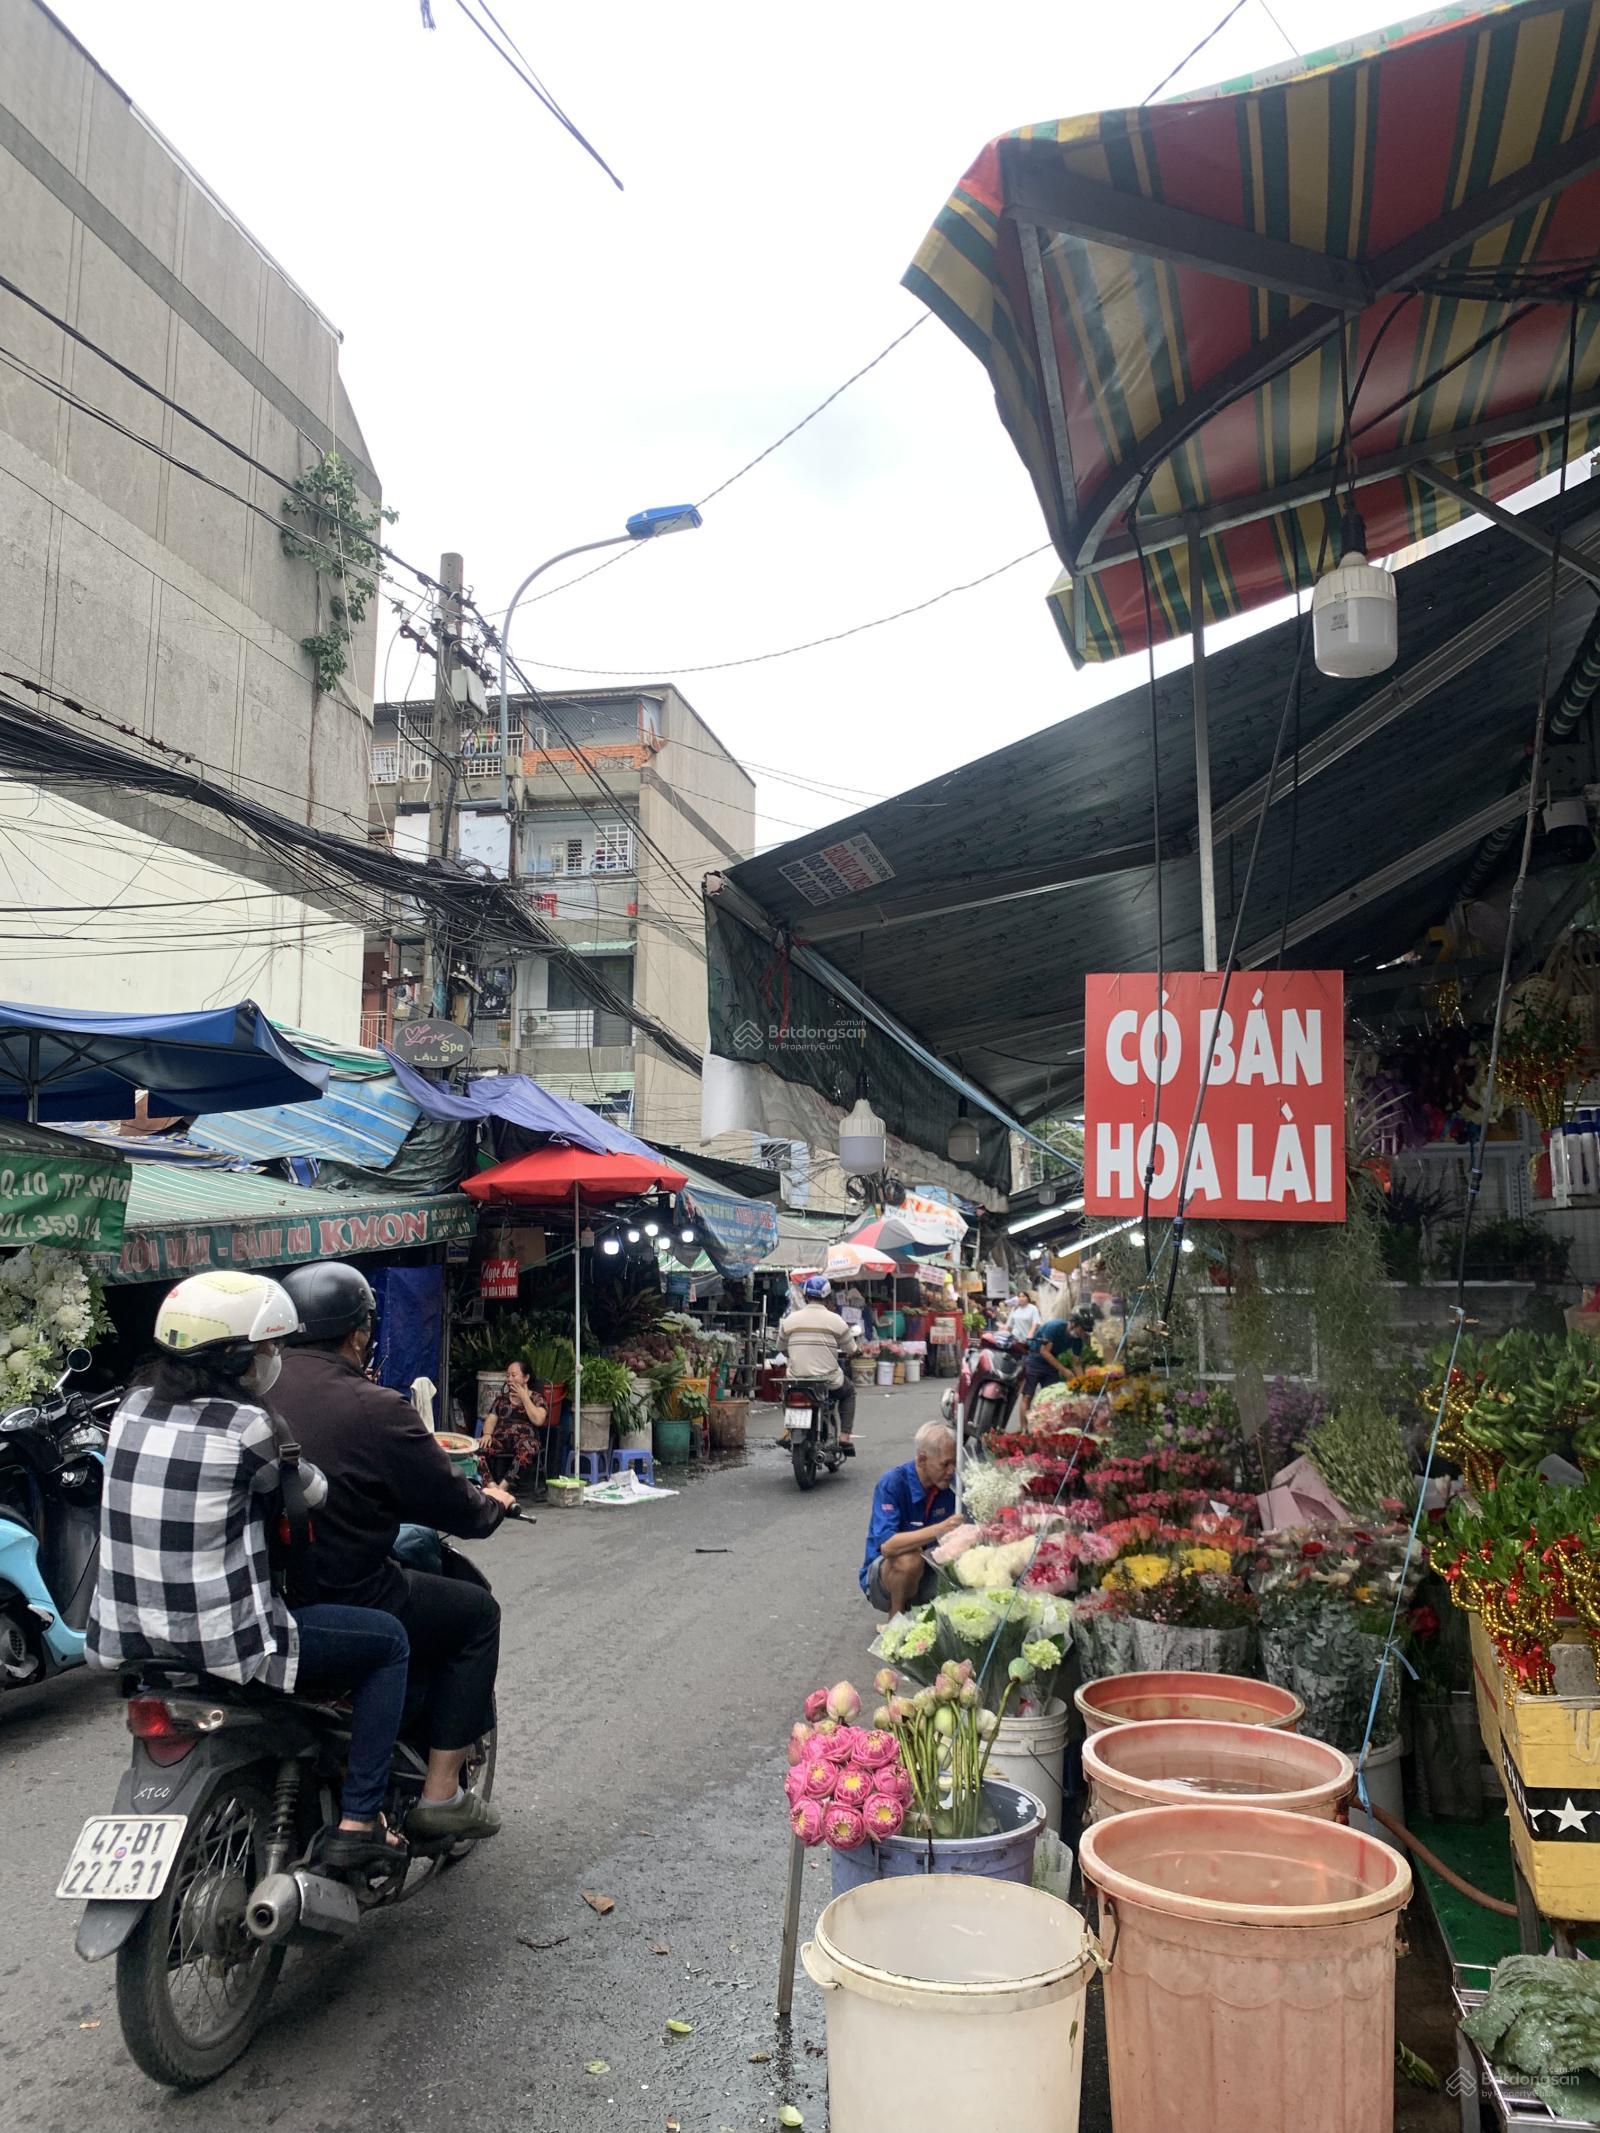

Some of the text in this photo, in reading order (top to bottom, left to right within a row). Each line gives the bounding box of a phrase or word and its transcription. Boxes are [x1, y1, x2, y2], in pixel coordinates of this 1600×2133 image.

[440, 1040, 464, 1054] Spa
[1105, 988, 1323, 1086] CÓ BÁN
[1096, 1103, 1332, 1203] HOA LÀI
[1, 1169, 48, 1200] Q.10
[319, 1210, 428, 1255] KMON
[91, 1823, 166, 1854] 47-B1
